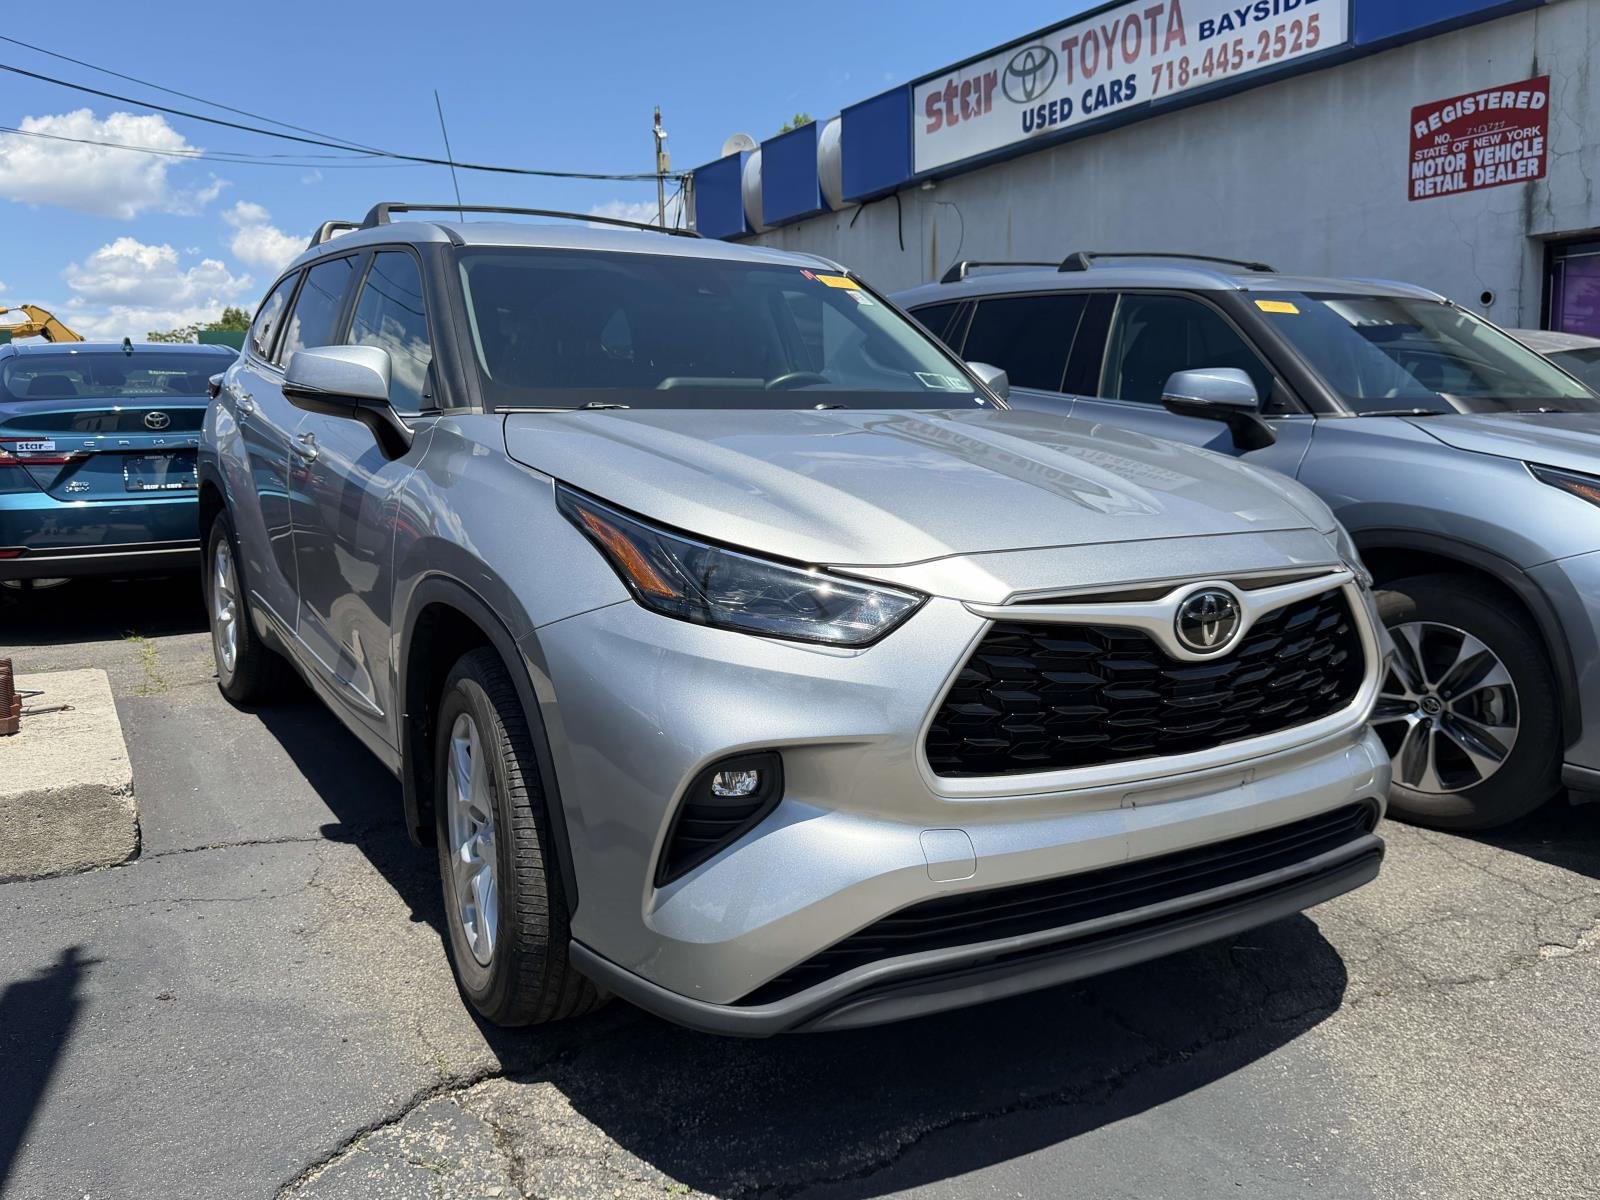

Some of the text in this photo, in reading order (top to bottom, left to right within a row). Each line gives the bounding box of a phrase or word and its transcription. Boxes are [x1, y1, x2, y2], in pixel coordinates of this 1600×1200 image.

[925, 0, 1319, 134] star TOYOTA BAYSID
[1022, 13, 1321, 133] USED CARS 718-445-2525
[1413, 91, 1546, 139] REGISTERED
[1412, 137, 1543, 179] MOTOR VEHICLE
[1415, 126, 1541, 160] STATE OF NEW YORK
[1414, 157, 1538, 197] RETAIL DEALER
[18, 442, 44, 450] star
